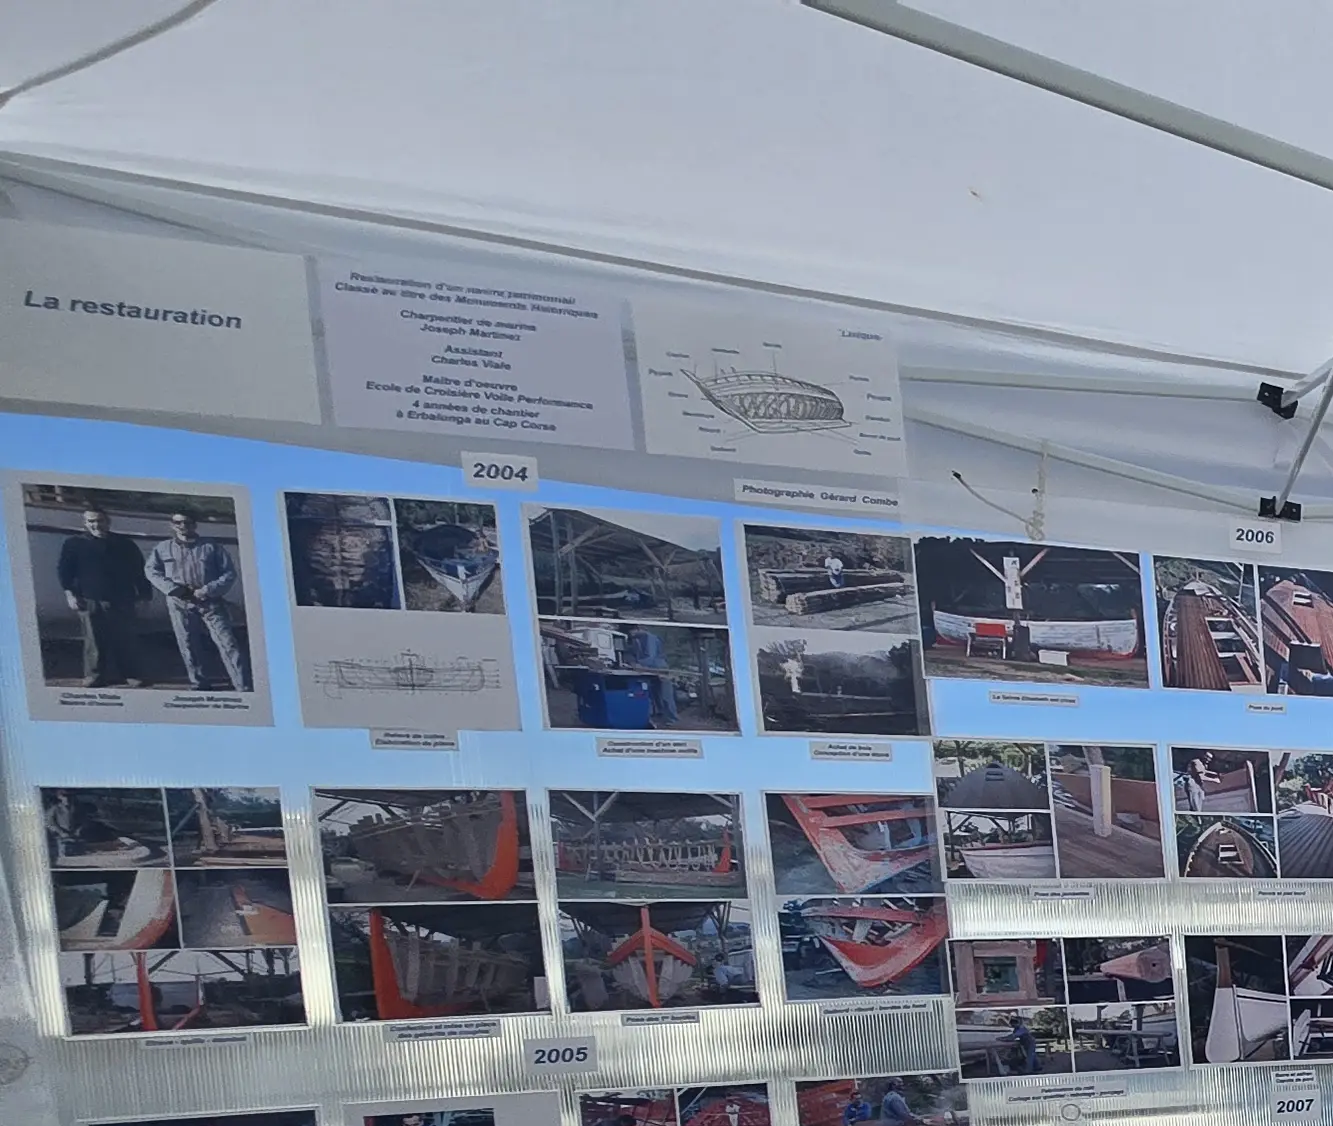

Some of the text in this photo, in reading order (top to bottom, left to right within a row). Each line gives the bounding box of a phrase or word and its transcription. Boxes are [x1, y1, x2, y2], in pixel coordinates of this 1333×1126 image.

[24, 290, 242, 329] La restauration
[493, 418, 517, 429] Cap
[473, 462, 528, 481] 2004
[742, 485, 815, 500] Photographie
[1236, 528, 1275, 543] 2006
[534, 1047, 589, 1064] 2005
[1276, 1099, 1314, 1113] 2007
